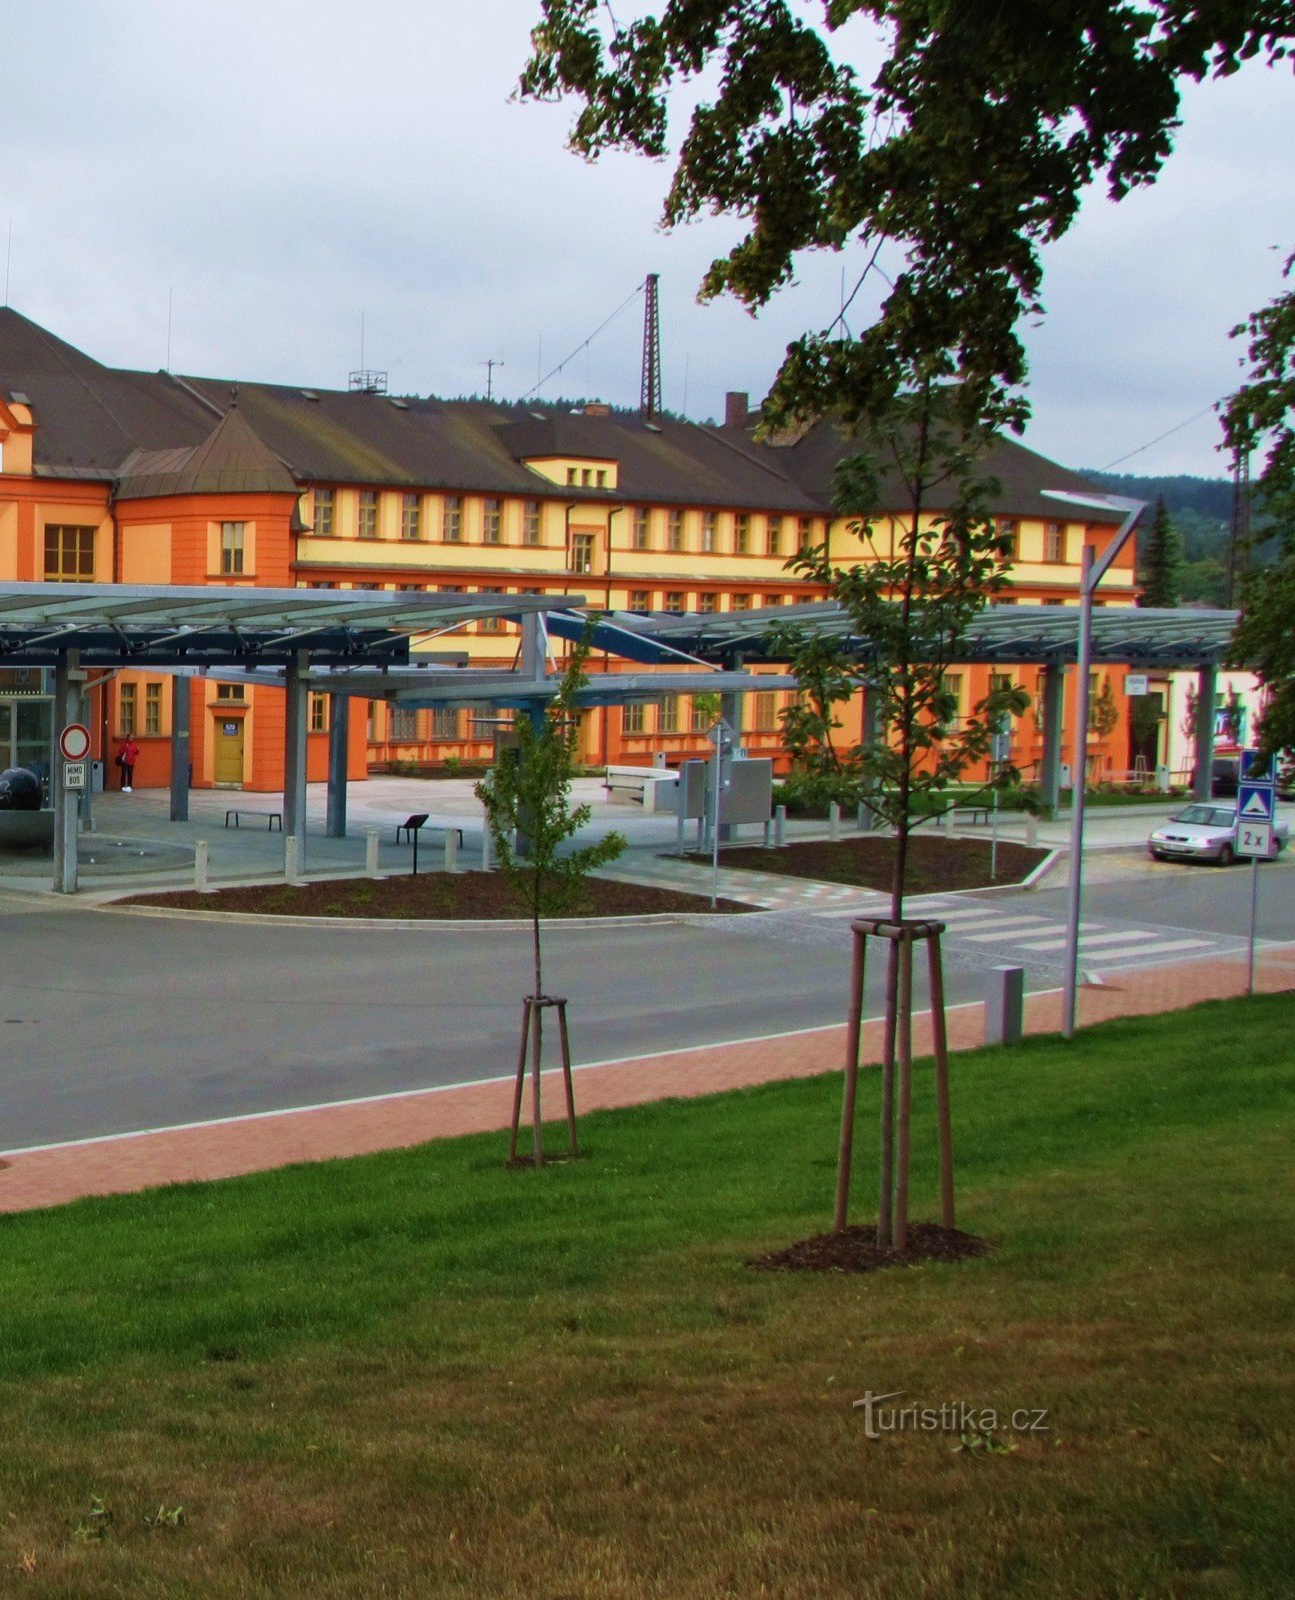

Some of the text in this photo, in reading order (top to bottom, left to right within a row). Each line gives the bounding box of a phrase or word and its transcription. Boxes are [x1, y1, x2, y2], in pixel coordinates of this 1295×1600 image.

[67, 766, 83, 774] MIMO
[69, 776, 81, 784] BUS
[1243, 831, 1252, 845] 2
